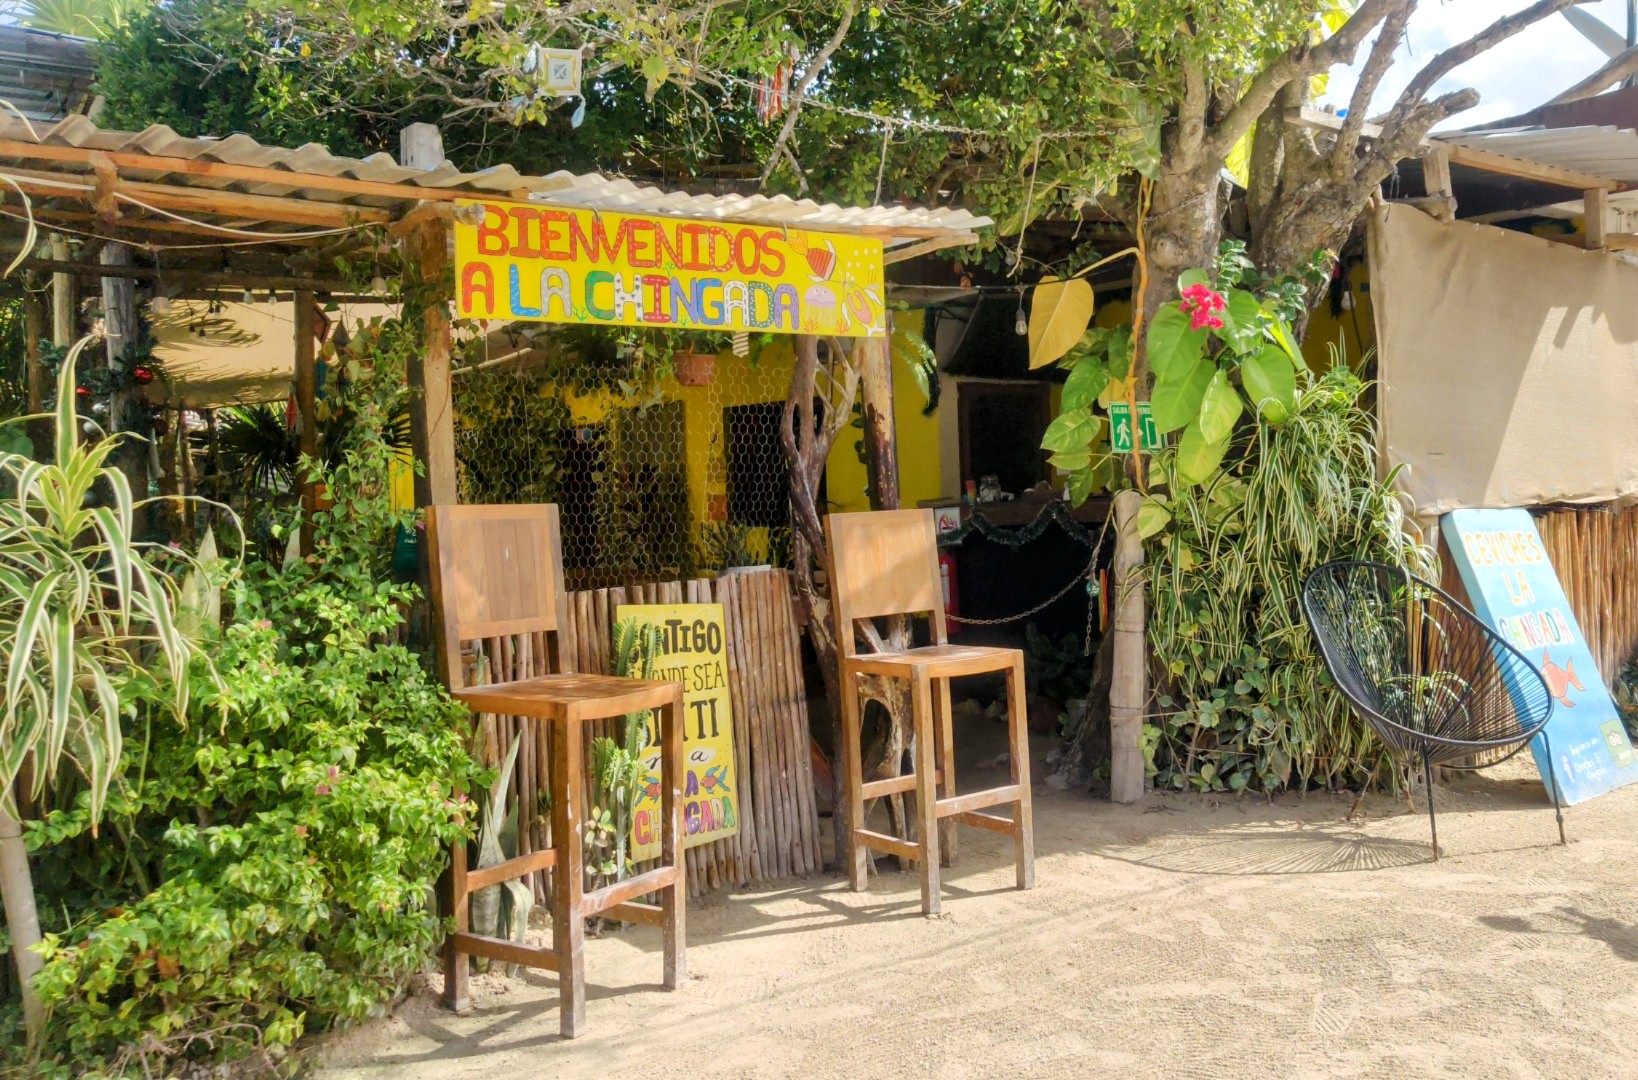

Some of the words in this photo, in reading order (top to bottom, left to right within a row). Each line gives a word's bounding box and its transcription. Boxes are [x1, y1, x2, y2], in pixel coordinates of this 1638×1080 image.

[477, 204, 786, 277] BIENVENIDOS
[462, 262, 495, 314] A
[509, 263, 572, 318] LA
[584, 271, 800, 330] CHINGADA
[1464, 531, 1543, 566] CEVICHES
[1503, 570, 1535, 604] LA
[1499, 608, 1575, 650] CHINGADA
[693, 660, 726, 691] SEA
[690, 698, 720, 740] TI
[634, 795, 736, 845] CHGADA
